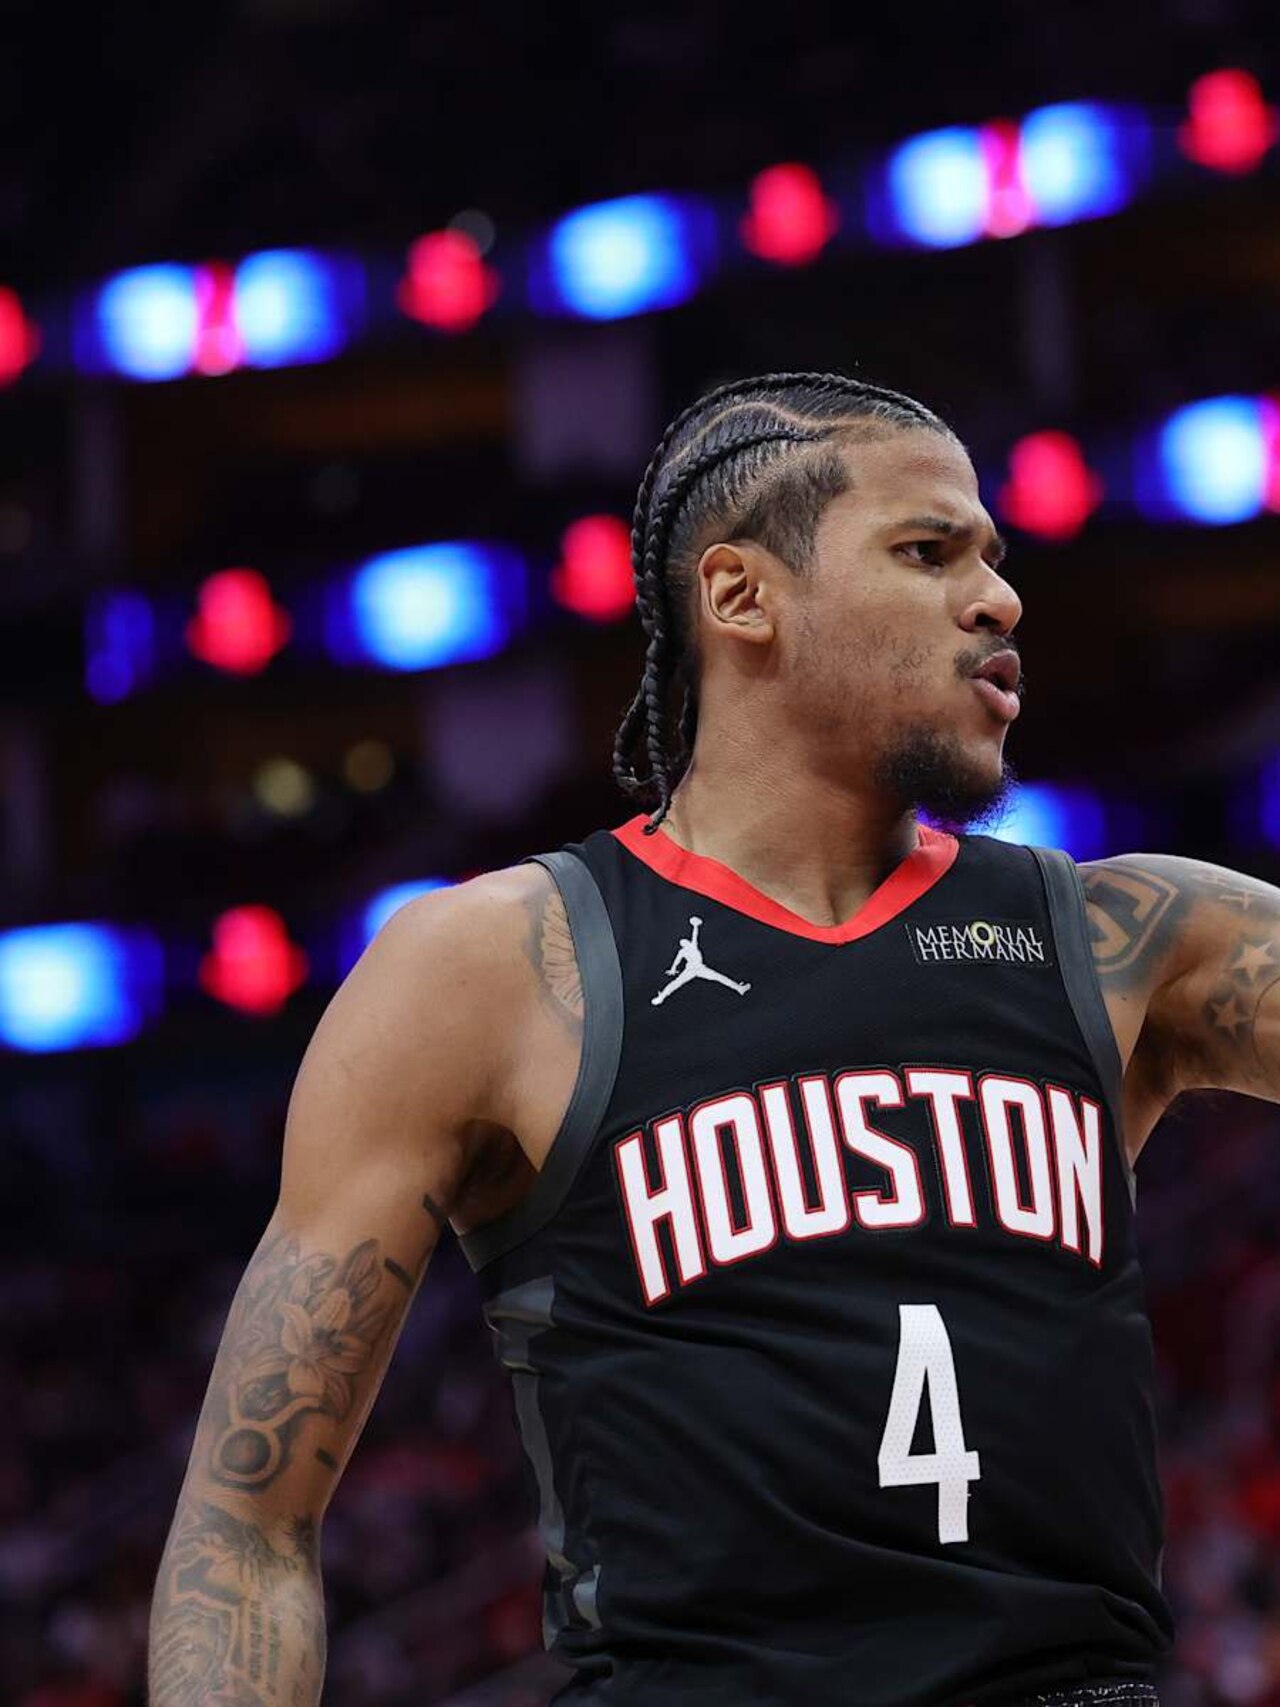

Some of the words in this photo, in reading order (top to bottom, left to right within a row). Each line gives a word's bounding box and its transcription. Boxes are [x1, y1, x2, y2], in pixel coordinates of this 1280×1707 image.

[915, 921, 1044, 946] MEMORIAL
[917, 941, 1045, 962] HERMANN
[614, 1068, 1102, 1308] HOUSTON
[877, 1303, 981, 1545] 4
